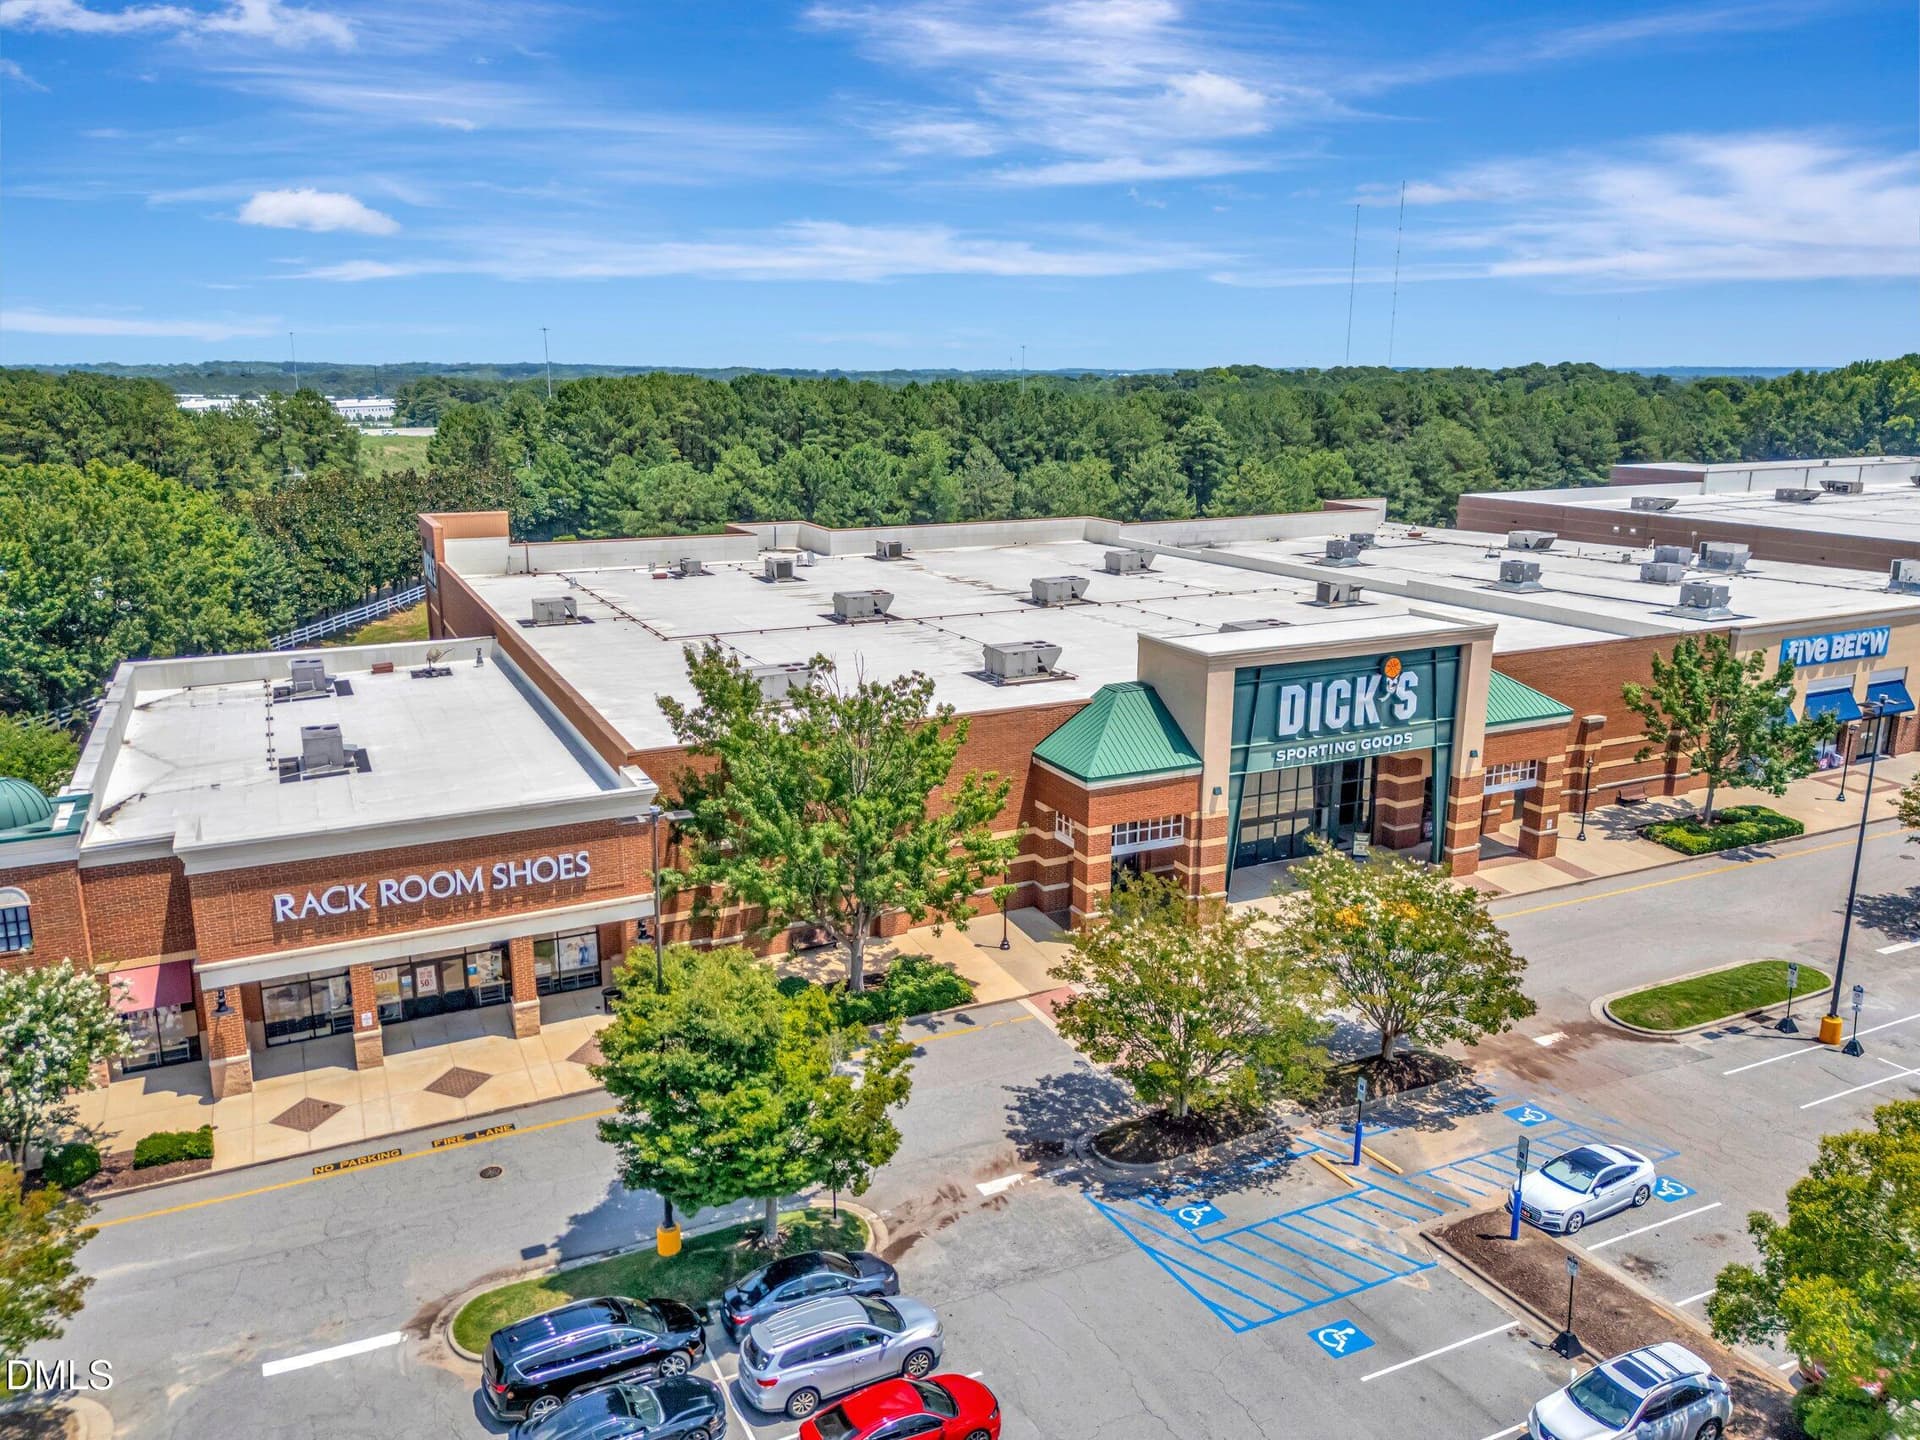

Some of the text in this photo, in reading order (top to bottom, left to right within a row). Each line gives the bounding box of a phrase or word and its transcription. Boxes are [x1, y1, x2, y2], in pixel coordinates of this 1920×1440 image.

[1278, 667, 1419, 736] DICK'S
[1276, 732, 1413, 762] SPORTING GOODS
[273, 850, 591, 922] RACK ROOM SHOES
[313, 1124, 515, 1176] NO PARKING FIRE LANE
